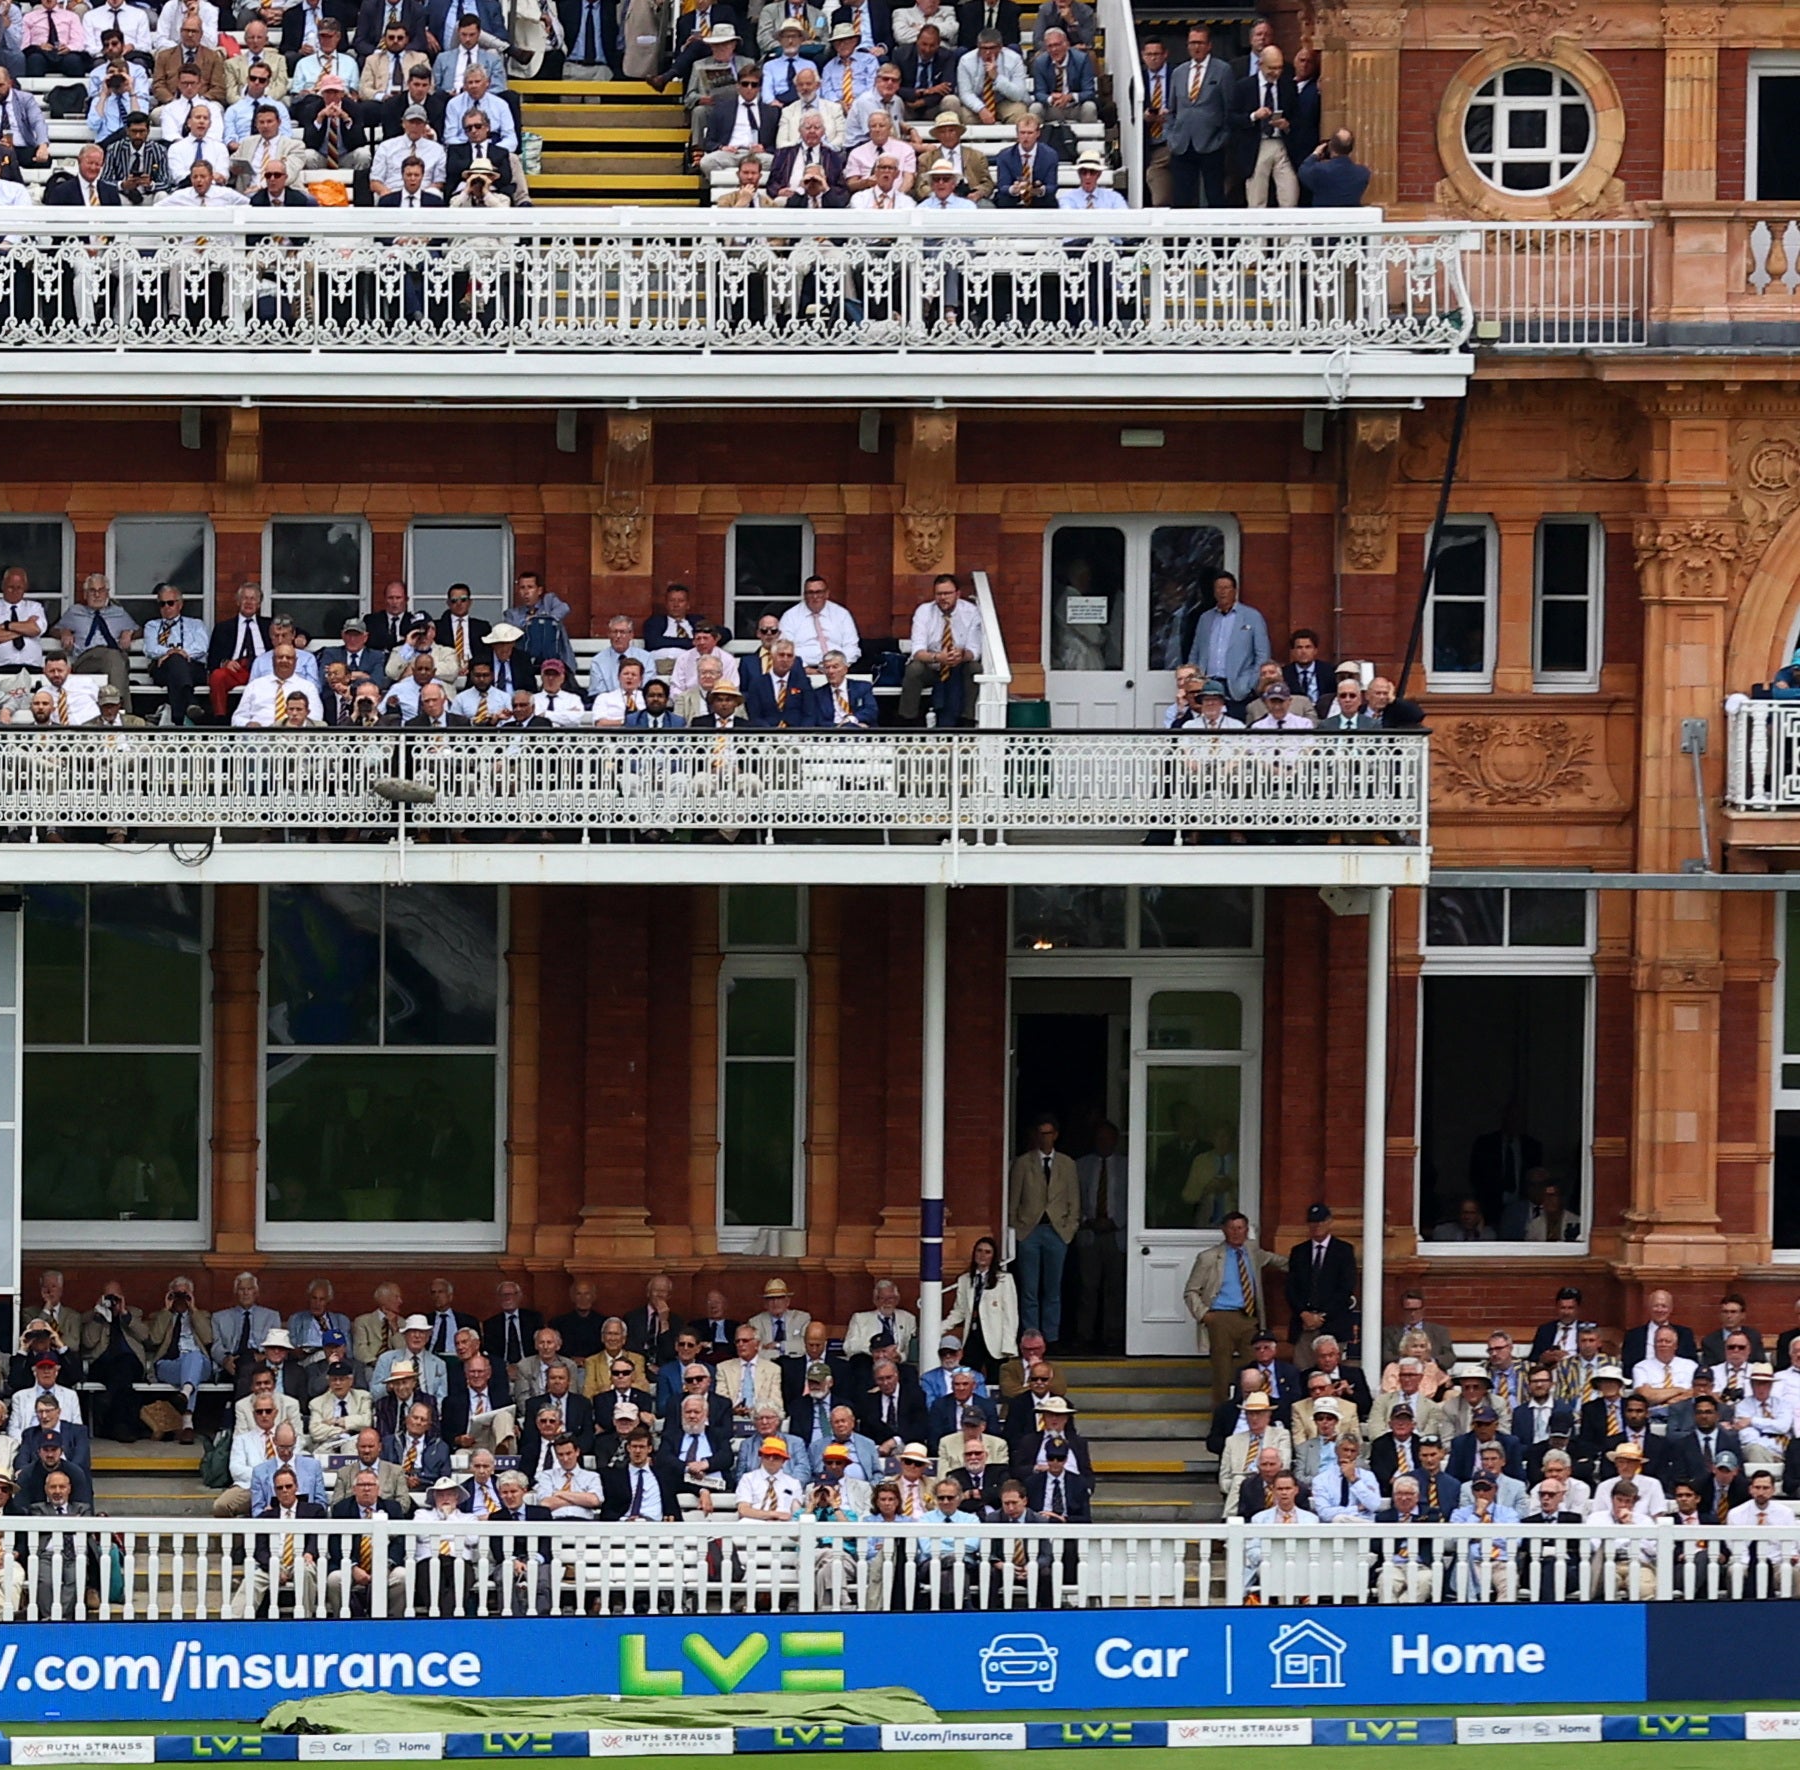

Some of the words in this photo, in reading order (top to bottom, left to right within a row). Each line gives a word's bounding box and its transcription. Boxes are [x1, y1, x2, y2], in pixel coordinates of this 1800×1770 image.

[1095, 1637, 1188, 1680] Car
[1391, 1634, 1546, 1675] Home
[1202, 1725, 1239, 1733] RUTH
[1242, 1724, 1300, 1733] STRAUSS
[1492, 1725, 1511, 1735] Car
[1558, 1723, 1591, 1734] Home
[625, 1734, 662, 1742] RUTH
[664, 1733, 721, 1741] STRAUSS
[894, 1730, 1013, 1743] LV.com/insurance
[46, 1743, 82, 1751] RUTH
[86, 1742, 143, 1751] STRAUSS
[332, 1742, 352, 1752] Car
[400, 1741, 431, 1752] Home
